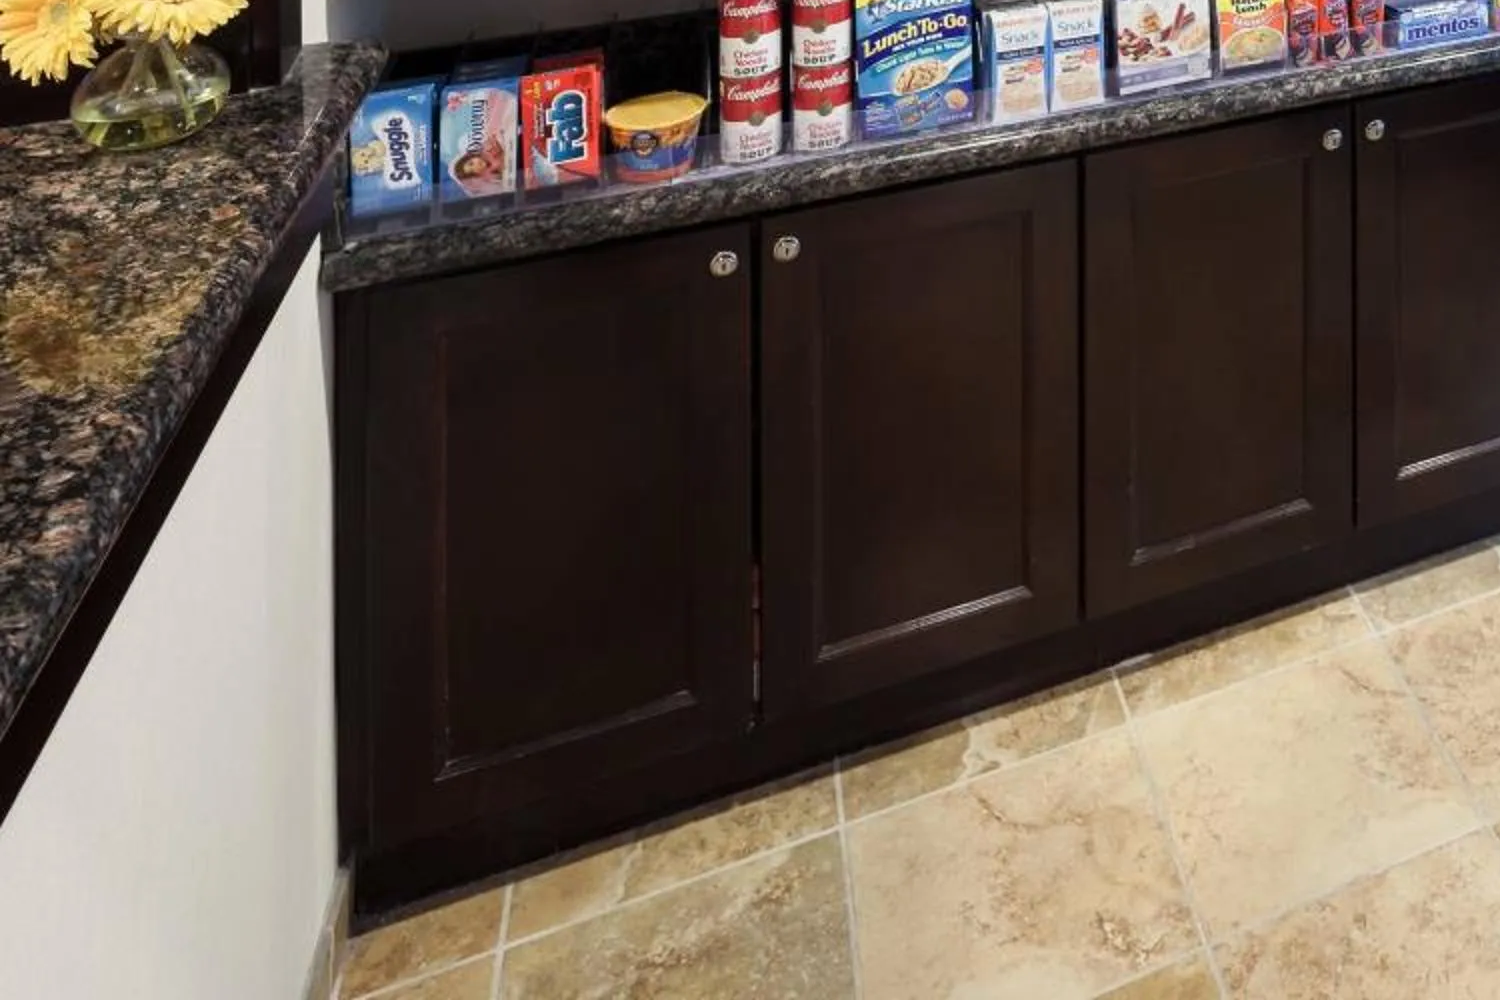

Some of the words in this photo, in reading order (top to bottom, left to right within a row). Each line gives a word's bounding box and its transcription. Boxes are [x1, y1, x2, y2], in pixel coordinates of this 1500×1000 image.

[862, 21, 918, 59] Lunch
[1406, 16, 1479, 42] mentos
[733, 65, 769, 76] SOUP
[803, 54, 836, 65] SOUP
[468, 99, 487, 155] Downy
[550, 92, 587, 163] Fab
[385, 117, 413, 183] Snuggle
[739, 148, 772, 160] SOUP
[808, 138, 842, 149] SOUP
